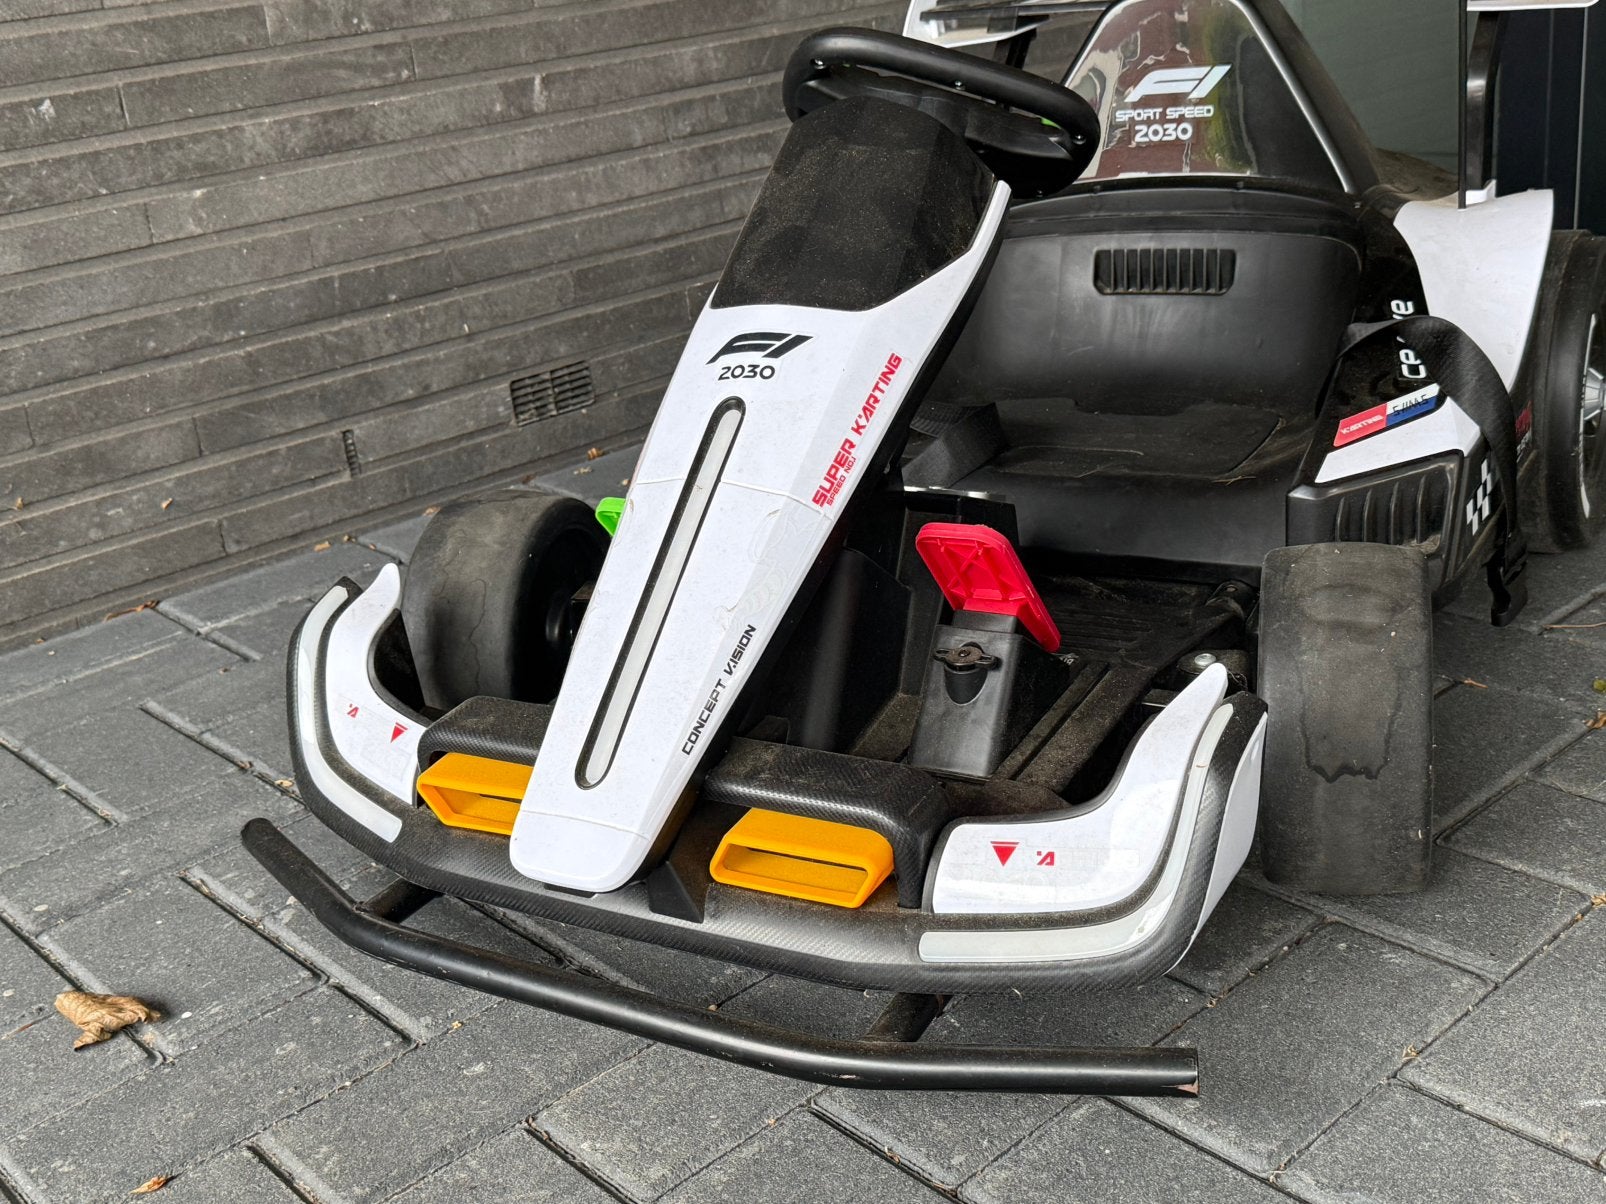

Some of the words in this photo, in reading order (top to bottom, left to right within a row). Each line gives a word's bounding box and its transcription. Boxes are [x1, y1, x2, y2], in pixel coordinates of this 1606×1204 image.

[1115, 107, 1163, 122] SPORT
[1165, 105, 1214, 119] SPEED
[1133, 122, 1193, 143] 2030
[718, 364, 776, 381] 2030
[812, 438, 857, 508] SUPER
[826, 474, 846, 507] SPEED
[681, 679, 726, 756] CONCEPT
